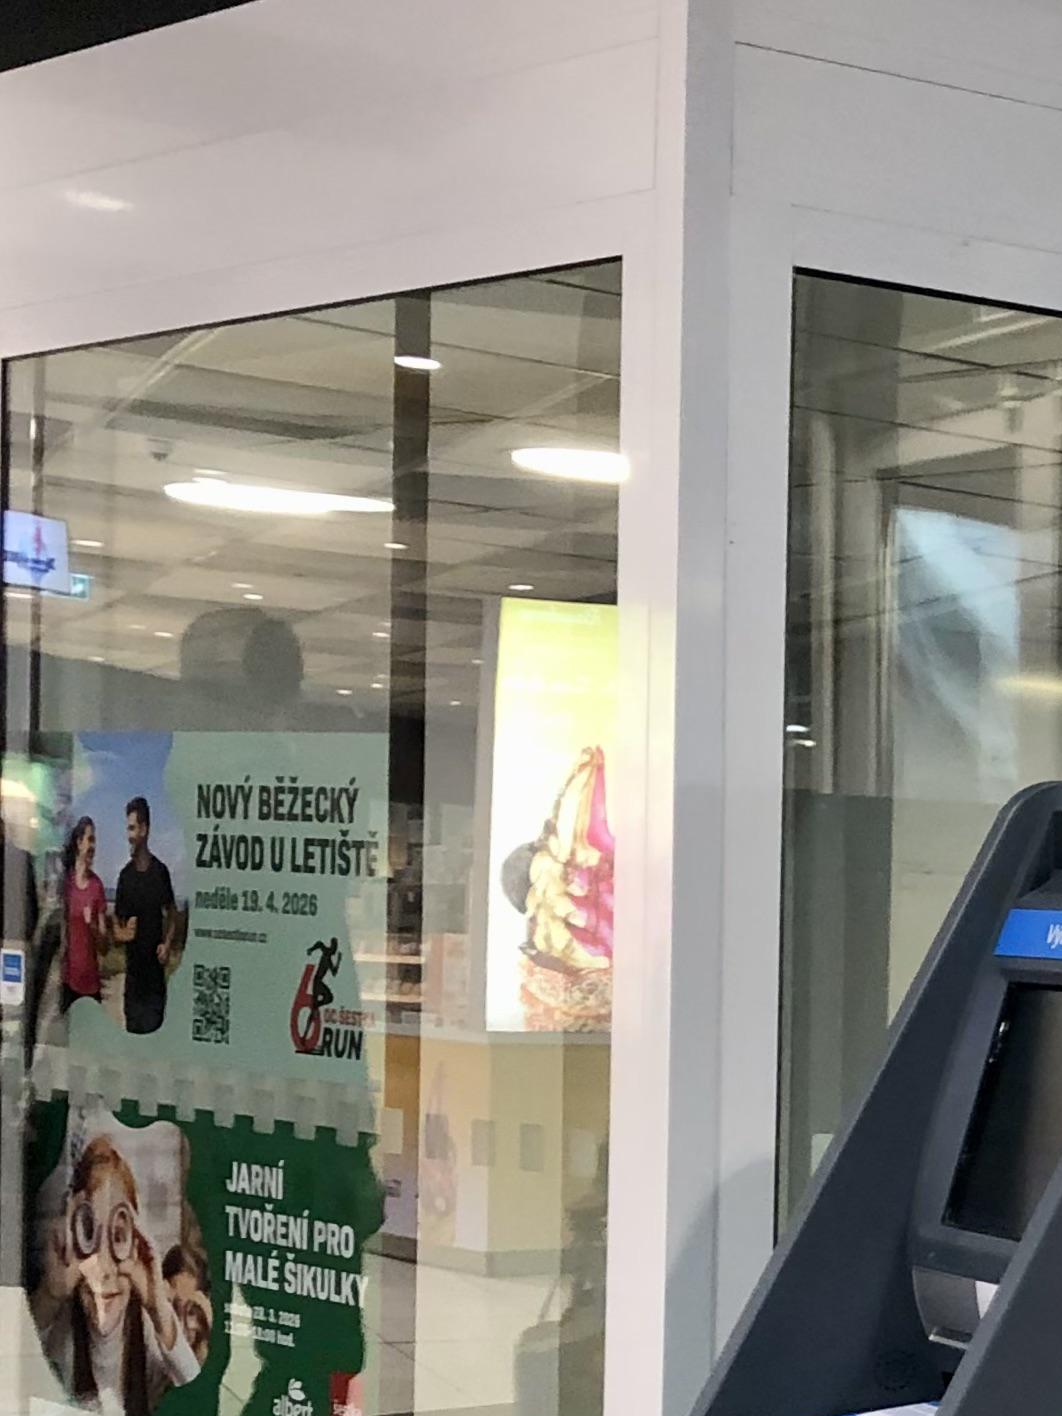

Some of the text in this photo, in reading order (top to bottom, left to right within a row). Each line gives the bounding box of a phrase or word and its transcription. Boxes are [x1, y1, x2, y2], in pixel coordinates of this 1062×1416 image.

[197, 775, 359, 823] NOVÝ BĚŽECKÝ
[196, 824, 379, 877] ZÁVOD U LETIŠTĚ
[194, 886, 239, 911] neděle
[282, 892, 318, 916] 2026
[322, 1027, 363, 1060] RUN
[225, 1160, 284, 1200] JARNÍ
[225, 1203, 355, 1258] TVOŘENÍ PRO
[225, 1250, 368, 1308] MALÉ ŠIKULKY
